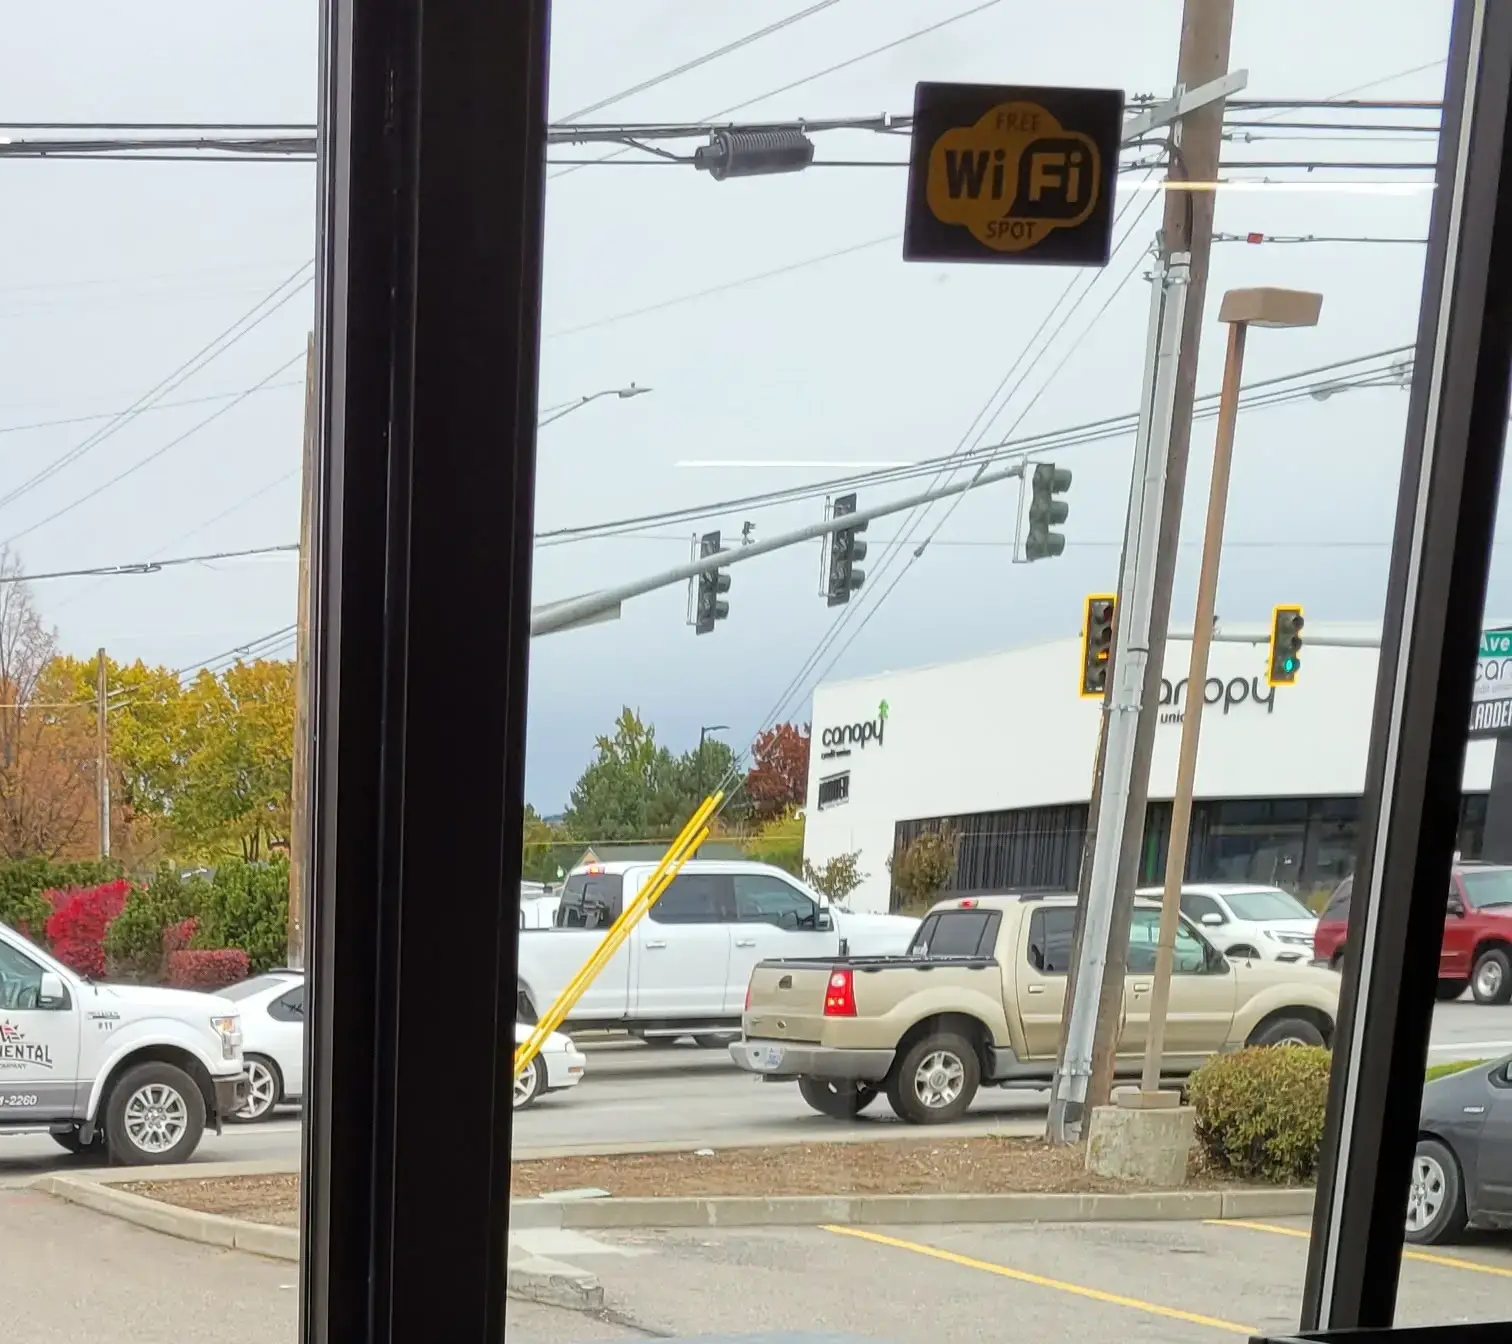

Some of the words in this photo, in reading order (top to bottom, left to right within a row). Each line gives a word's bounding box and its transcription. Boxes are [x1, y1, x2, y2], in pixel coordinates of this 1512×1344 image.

[995, 111, 1042, 132] FREE
[986, 220, 1038, 240] SPOT
[822, 719, 884, 749] canopy
